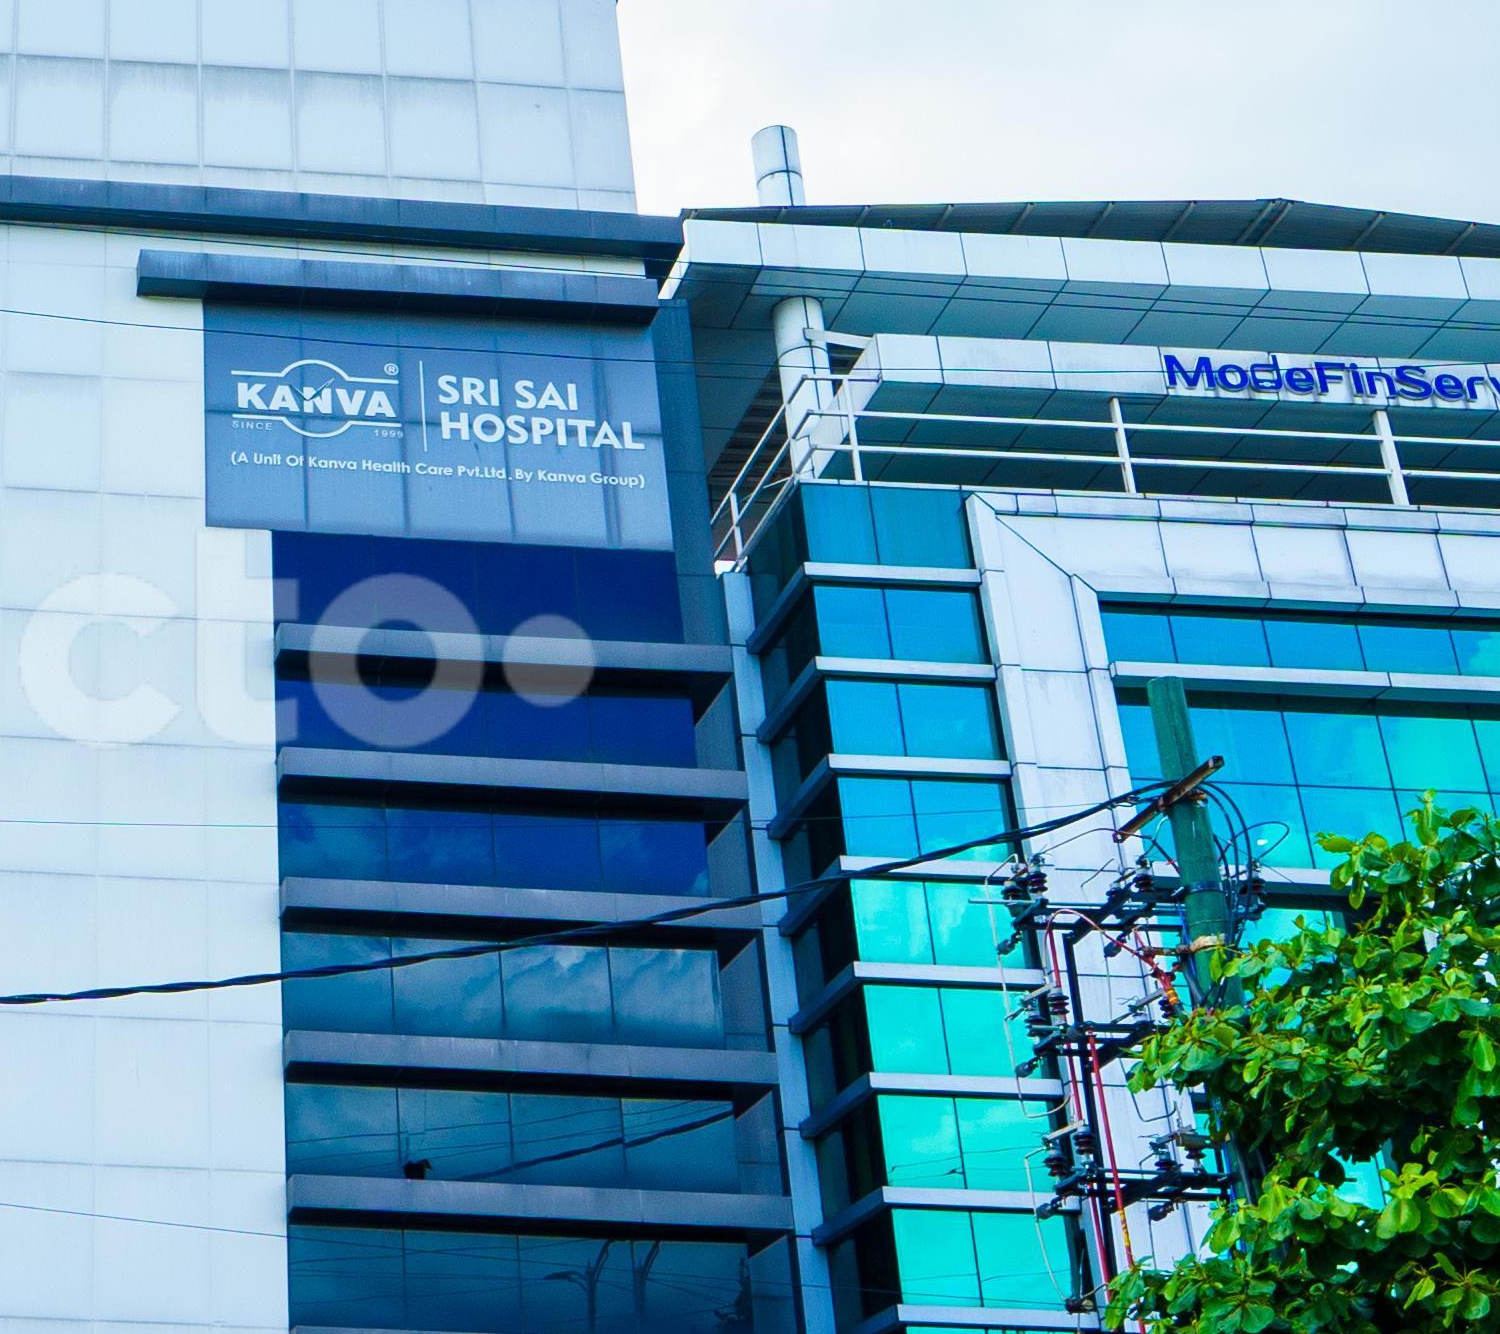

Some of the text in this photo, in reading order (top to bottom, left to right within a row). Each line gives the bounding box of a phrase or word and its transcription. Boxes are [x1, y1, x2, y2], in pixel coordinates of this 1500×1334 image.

[237, 382, 396, 418] KANVA
[437, 374, 579, 411] SRI SAI
[231, 420, 404, 439] SINCE 1999
[440, 411, 645, 450] HOSPITAL
[231, 450, 249, 465] (A
[254, 452, 282, 466] Unit
[286, 455, 304, 467] Of
[308, 456, 357, 471] Kanva
[361, 460, 411, 475] Health
[415, 462, 453, 476] Care
[515, 468, 533, 483] By
[537, 470, 587, 484] Kanva
[590, 472, 645, 489] Group)
